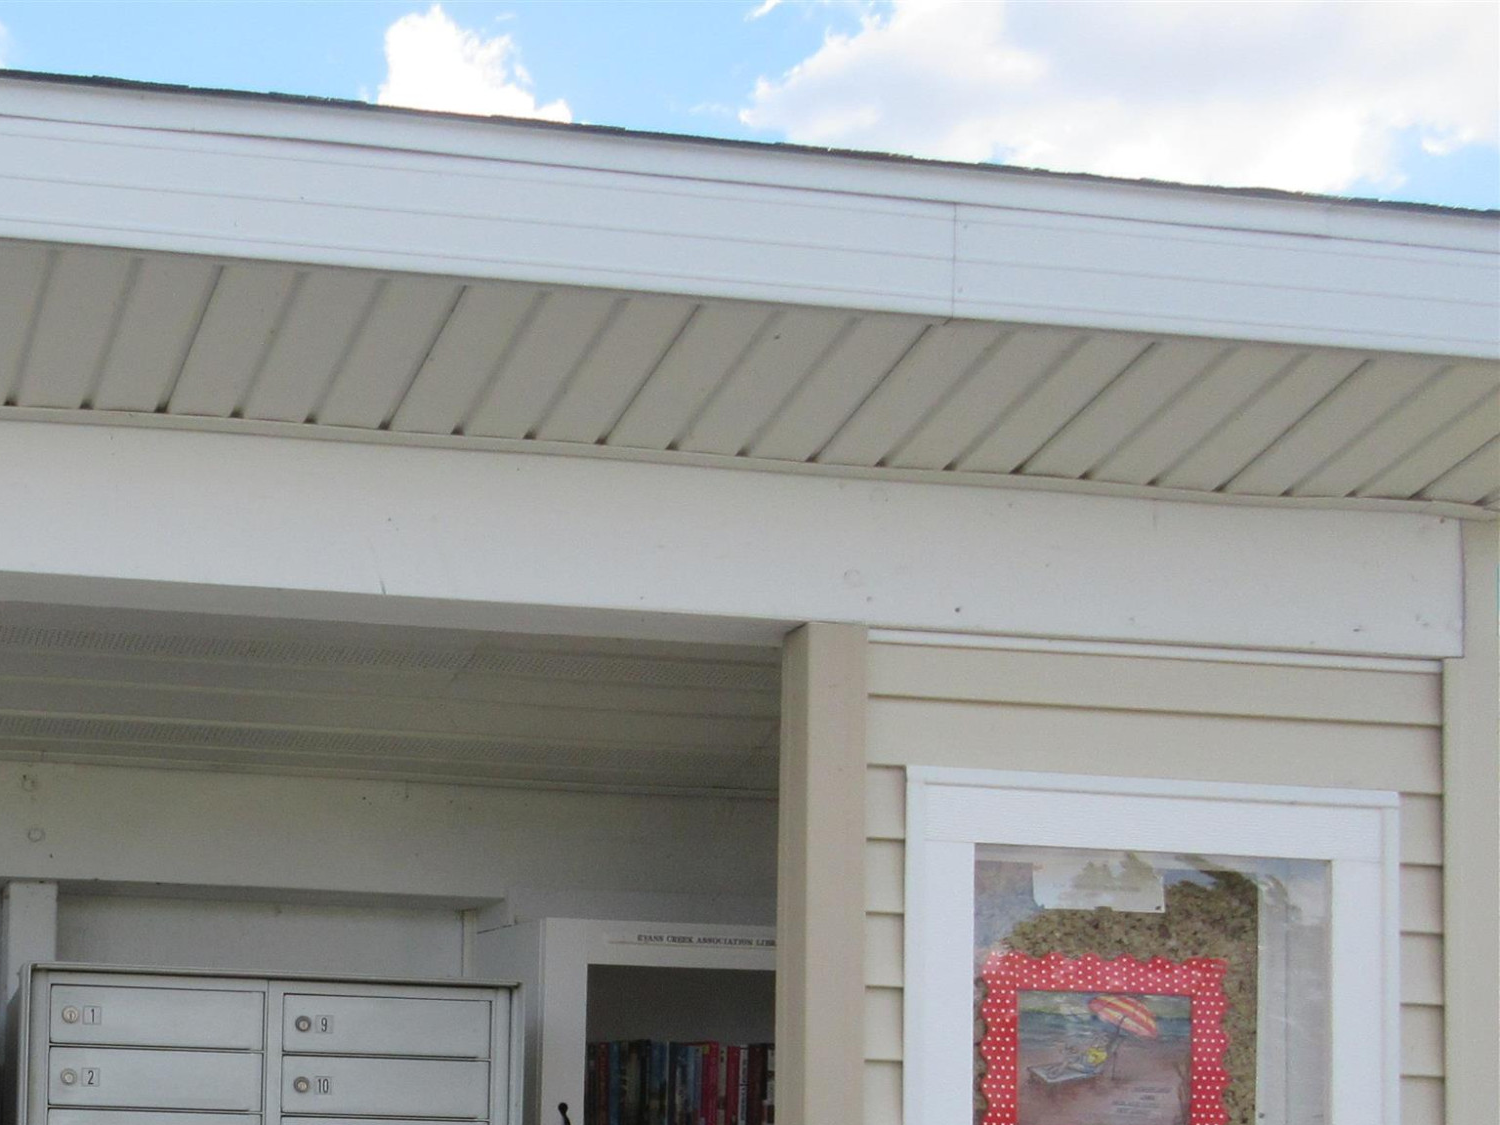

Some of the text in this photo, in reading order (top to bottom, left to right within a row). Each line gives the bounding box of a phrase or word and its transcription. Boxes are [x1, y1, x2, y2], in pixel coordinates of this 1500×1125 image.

[637, 934, 664, 942] EVANS
[666, 935, 694, 943] CREEK
[697, 937, 754, 946] ASSOCIATION
[320, 1016, 328, 1032] 9
[87, 1070, 95, 1085] 2
[316, 1078, 330, 1094] 10
